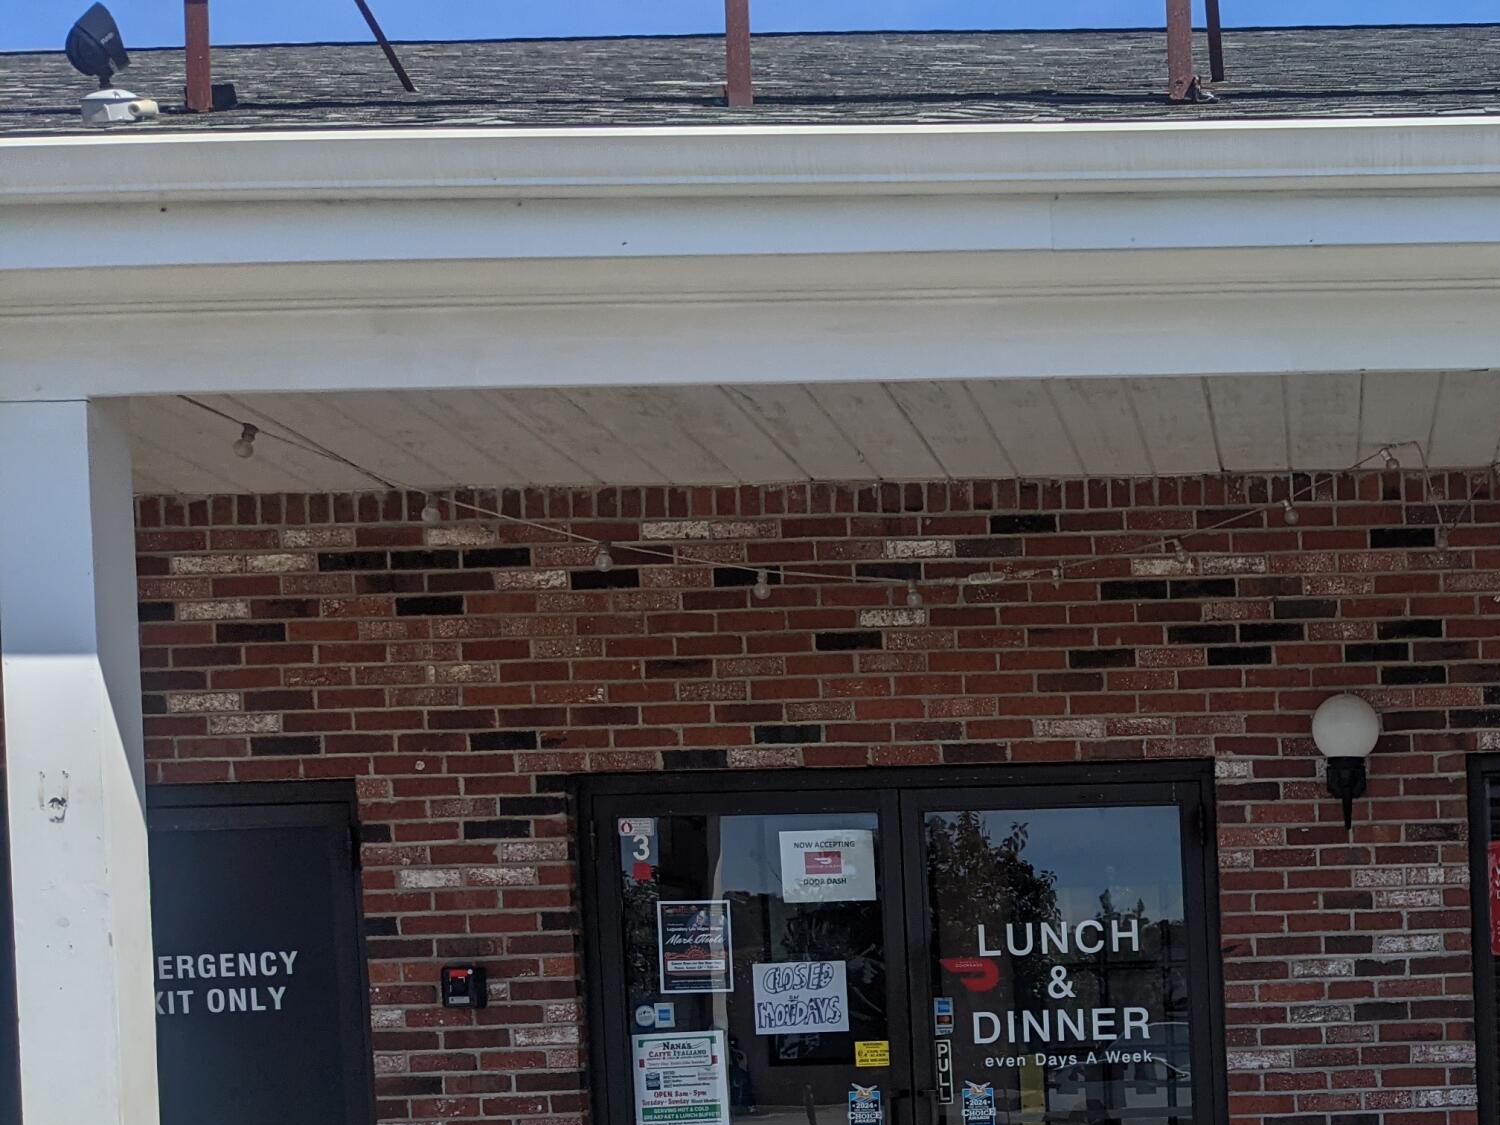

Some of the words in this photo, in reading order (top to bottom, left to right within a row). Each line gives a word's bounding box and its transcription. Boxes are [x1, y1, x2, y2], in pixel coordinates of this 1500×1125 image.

[632, 834, 650, 861] 3
[793, 841, 813, 849] NOW
[814, 840, 856, 848] ACCEPTING
[803, 878, 826, 886] DOOR
[977, 919, 1140, 957] LUNCH
[762, 962, 835, 994] CLOSED
[1047, 965, 1077, 999] &
[206, 986, 286, 1013] ONLY
[757, 995, 842, 1029] MONDAYS
[972, 1006, 1151, 1044] DINNER
[937, 1043, 951, 1101] PULL
[984, 1056, 1026, 1068] even
[1035, 1052, 1078, 1068] Days
[1086, 1051, 1098, 1064] A
[1105, 1049, 1153, 1064] Week
[848, 1111, 882, 1120] CHOICE
[962, 1107, 996, 1117] CHOICE
